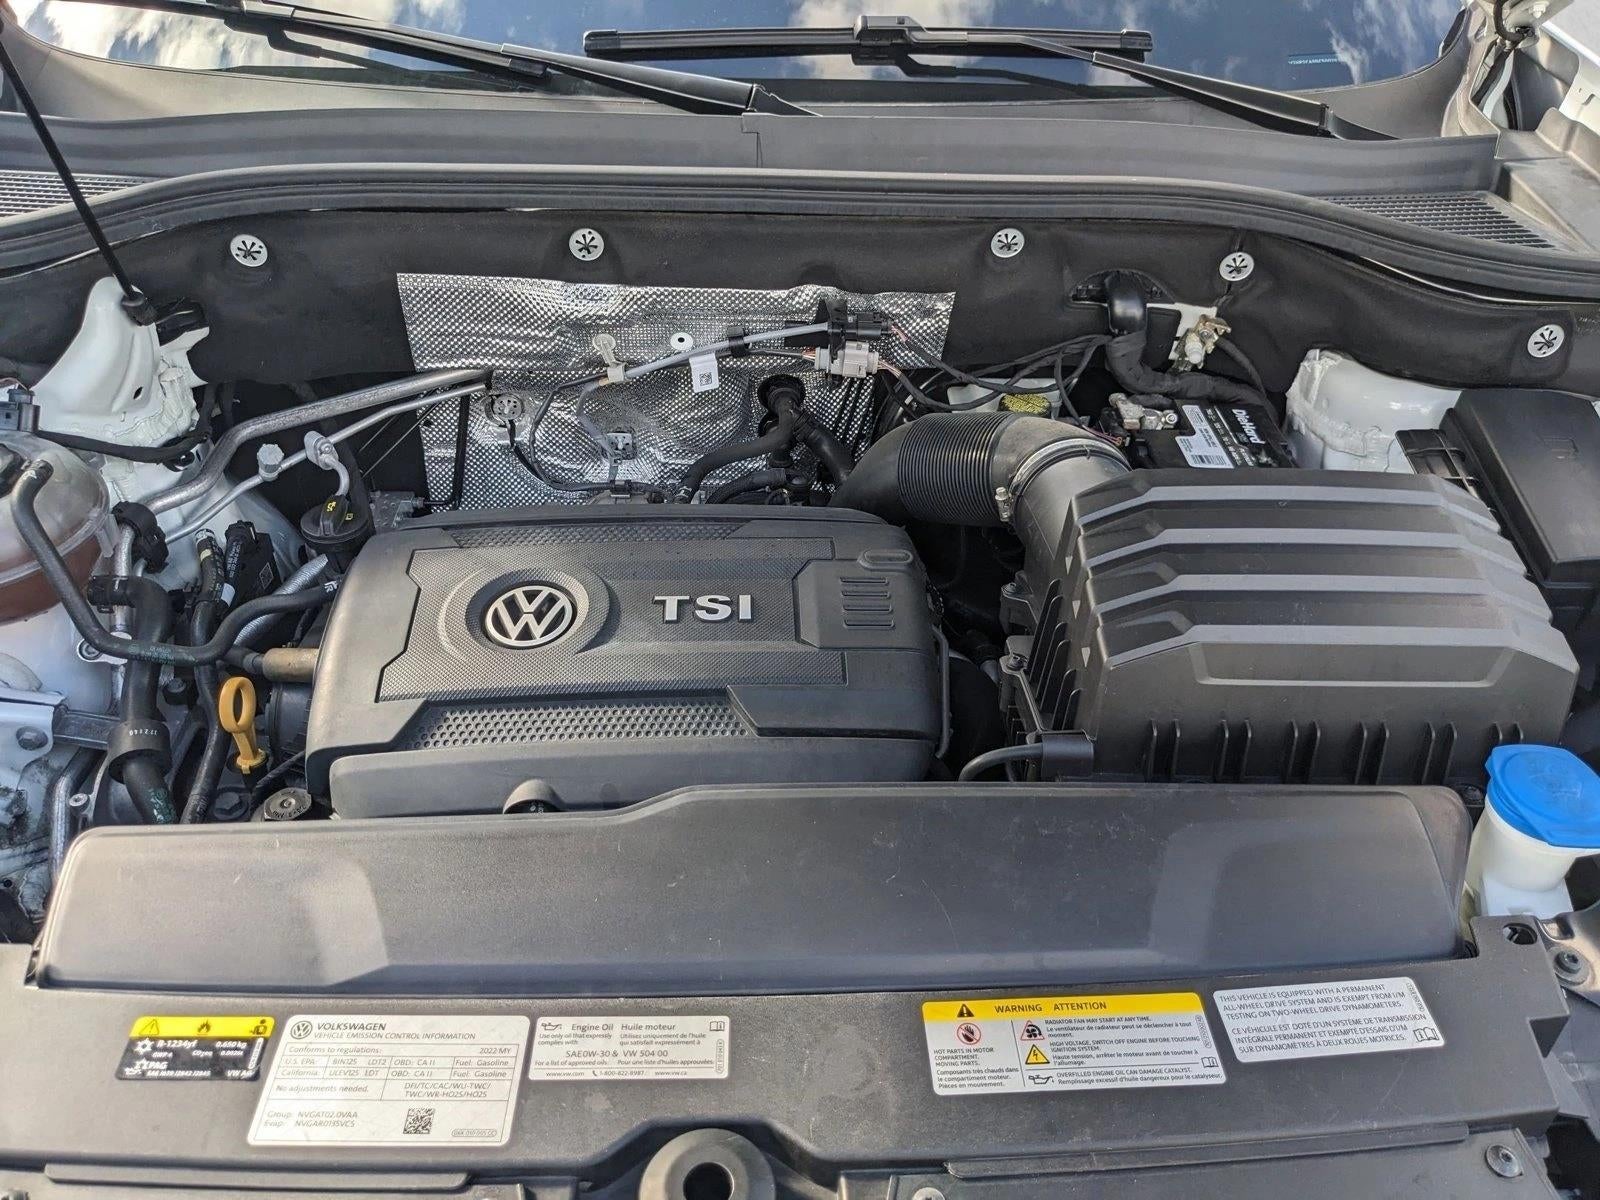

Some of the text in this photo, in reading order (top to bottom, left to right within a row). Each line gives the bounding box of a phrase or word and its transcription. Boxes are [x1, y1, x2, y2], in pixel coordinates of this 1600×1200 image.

[1232, 408, 1266, 444] DieHard
[654, 595, 752, 620] TSI
[1277, 990, 1313, 998] EQUIPPED
[1342, 984, 1385, 992] PERMANENT
[995, 1002, 1106, 1013] WARNING ATTENTION
[1224, 1003, 1263, 1012] ALL-WHEEL
[1342, 994, 1370, 1002] EXEMPT
[1226, 1012, 1257, 1020] TESTING
[1272, 1008, 1318, 1016] TWO-WHEEL
[317, 1022, 386, 1030] VOLKSWAGEN
[572, 1024, 600, 1032] Engine
[1242, 1025, 1278, 1034] VÉHICULE
[1376, 1013, 1426, 1024] TRANSMISSION
[1275, 1032, 1318, 1041] PERMANENT
[1239, 1046, 1254, 1054] SUR
[1322, 1038, 1342, 1046] DEUX
[1344, 1036, 1368, 1044] ROUES
[937, 1068, 971, 1076] Composants
[944, 1075, 986, 1083] compartiment
[289, 1086, 337, 1094] adjustments
